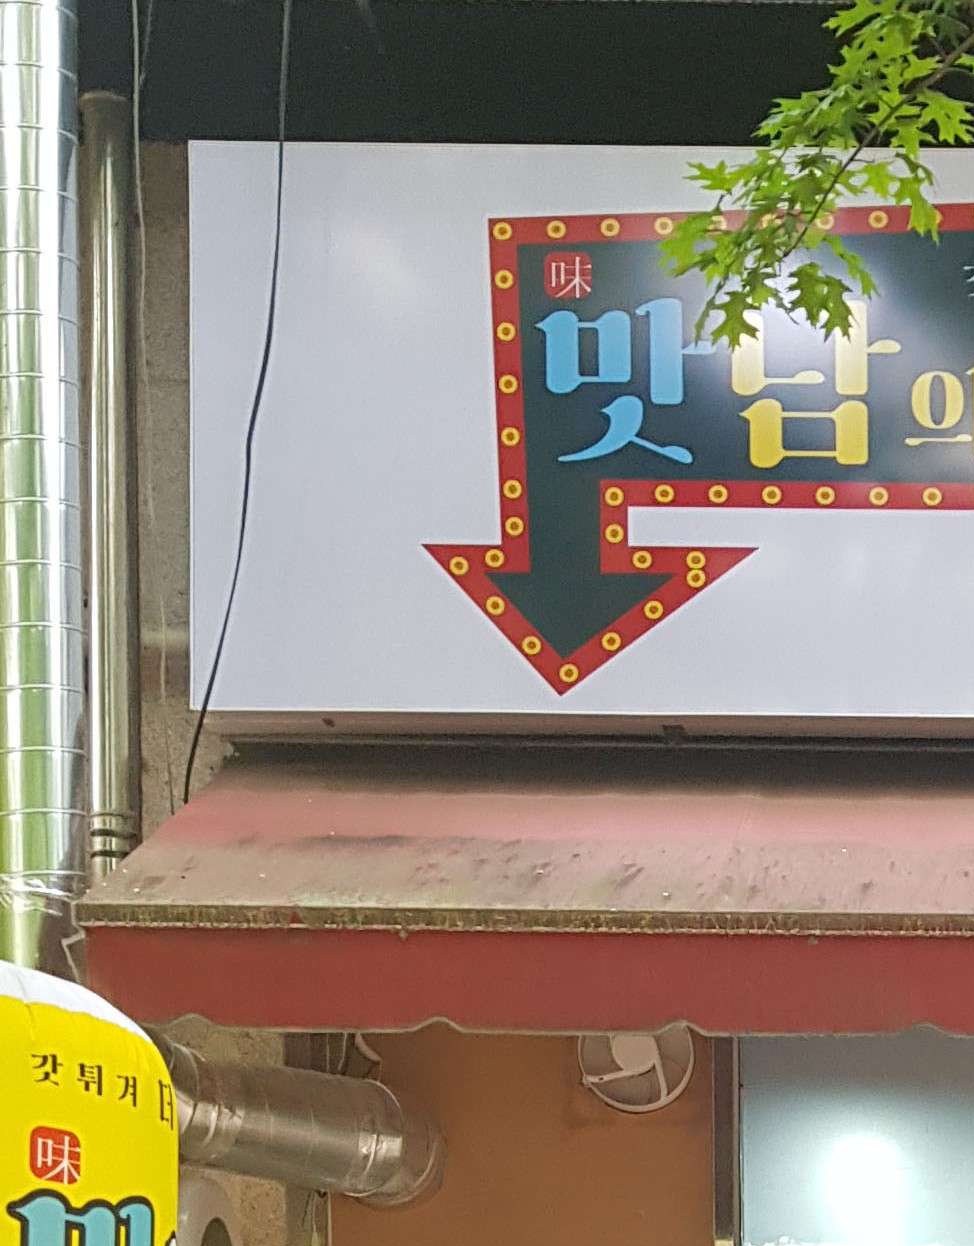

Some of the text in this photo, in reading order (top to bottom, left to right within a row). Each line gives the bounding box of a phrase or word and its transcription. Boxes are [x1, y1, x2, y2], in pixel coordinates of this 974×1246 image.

[550, 260, 592, 299] 味
[31, 1053, 138, 1108] 갓튀겨
[35, 1135, 81, 1185] 味
